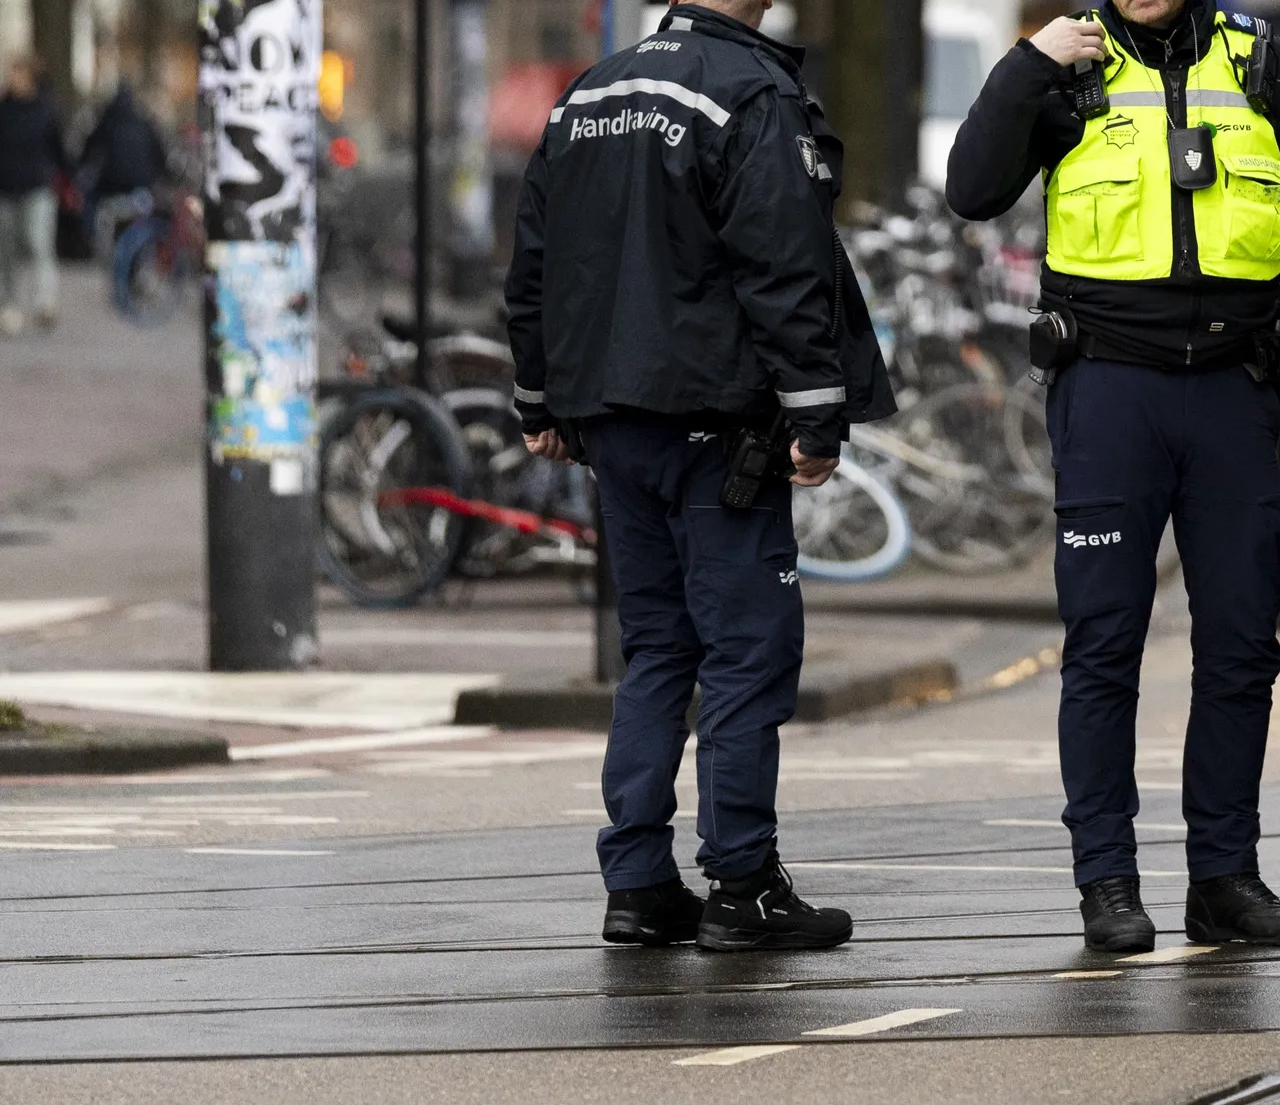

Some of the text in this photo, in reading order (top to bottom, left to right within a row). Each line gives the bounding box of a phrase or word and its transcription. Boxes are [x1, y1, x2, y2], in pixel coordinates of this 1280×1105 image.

[655, 40, 682, 52] GVB
[1233, 124, 1252, 132] GVB
[1088, 531, 1122, 547] GVB
